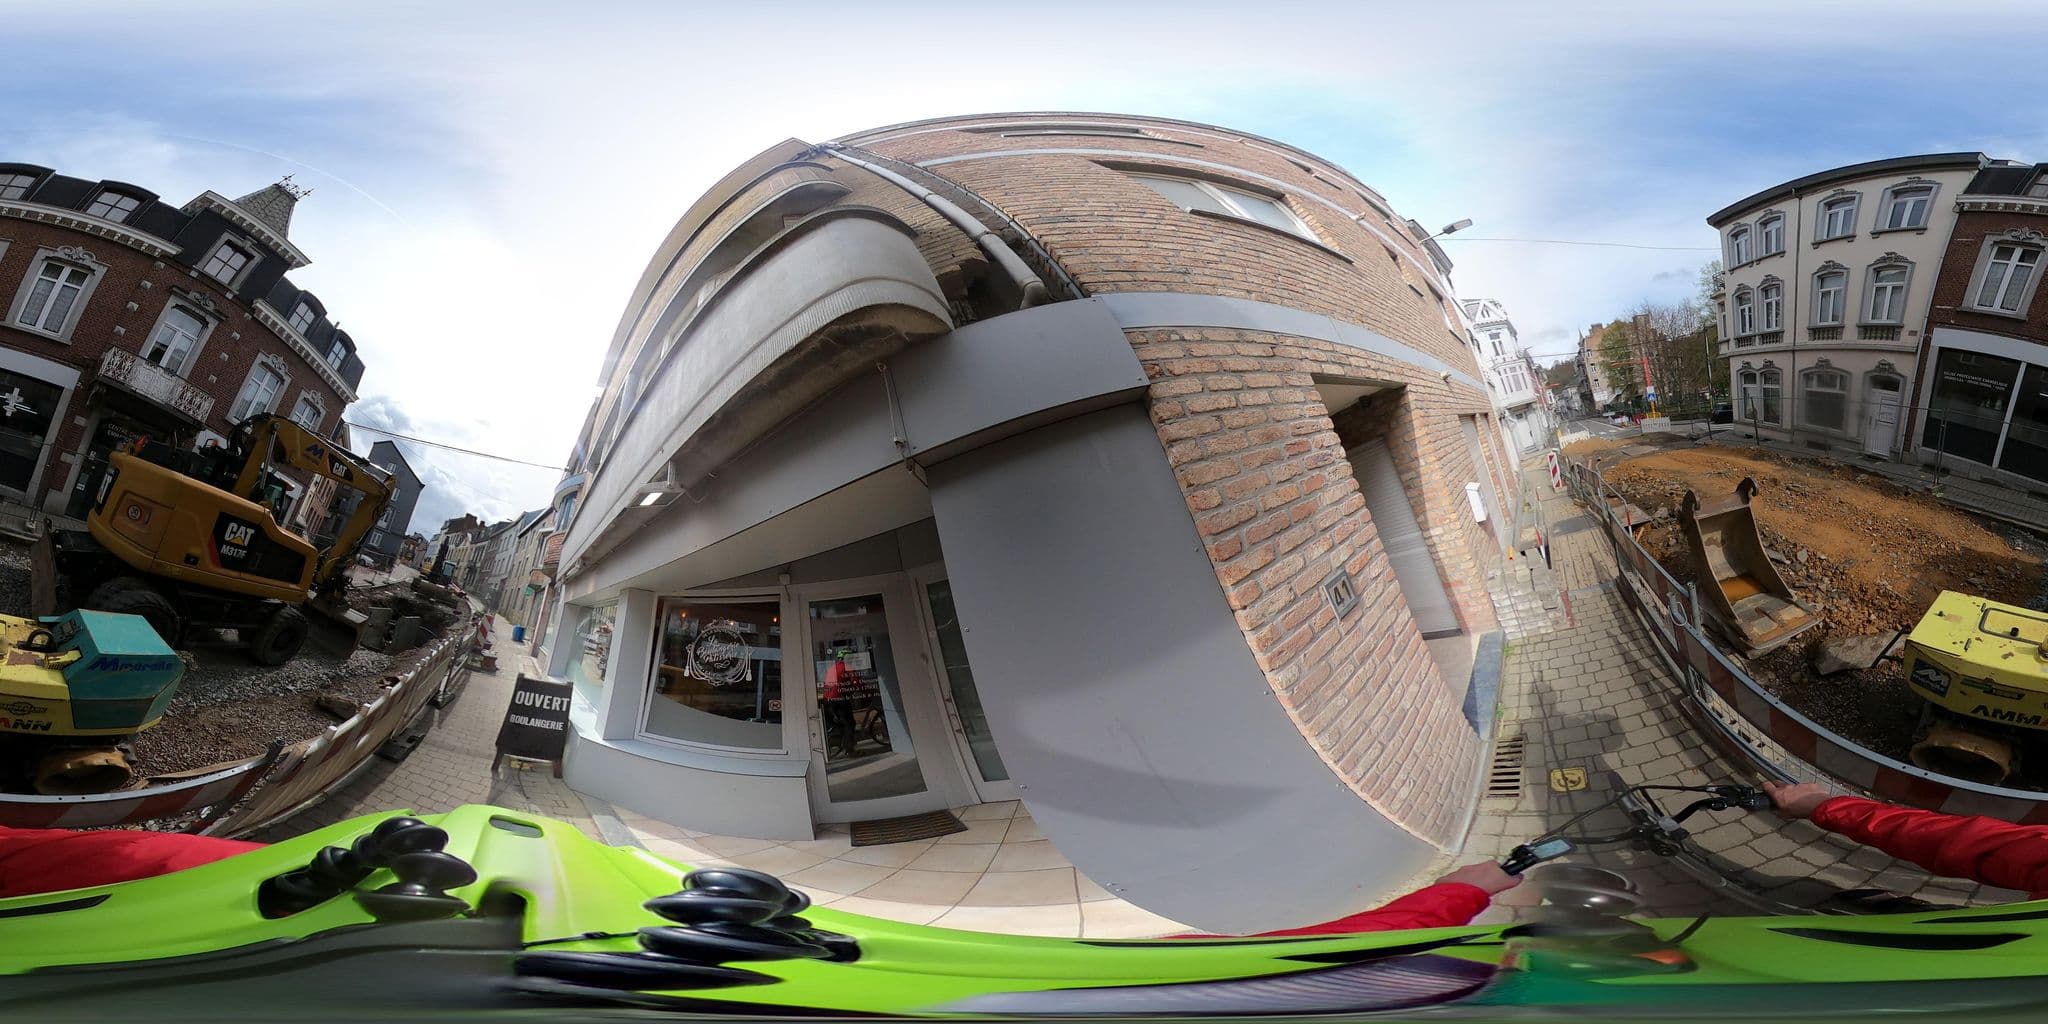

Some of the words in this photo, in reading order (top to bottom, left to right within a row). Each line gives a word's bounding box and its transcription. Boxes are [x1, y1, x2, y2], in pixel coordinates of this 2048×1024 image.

[332, 462, 348, 477] CAT
[224, 522, 256, 547] CAT
[1333, 579, 1352, 607] 41
[514, 690, 570, 711] OUVERT
[509, 714, 564, 731] BOULANGERIE
